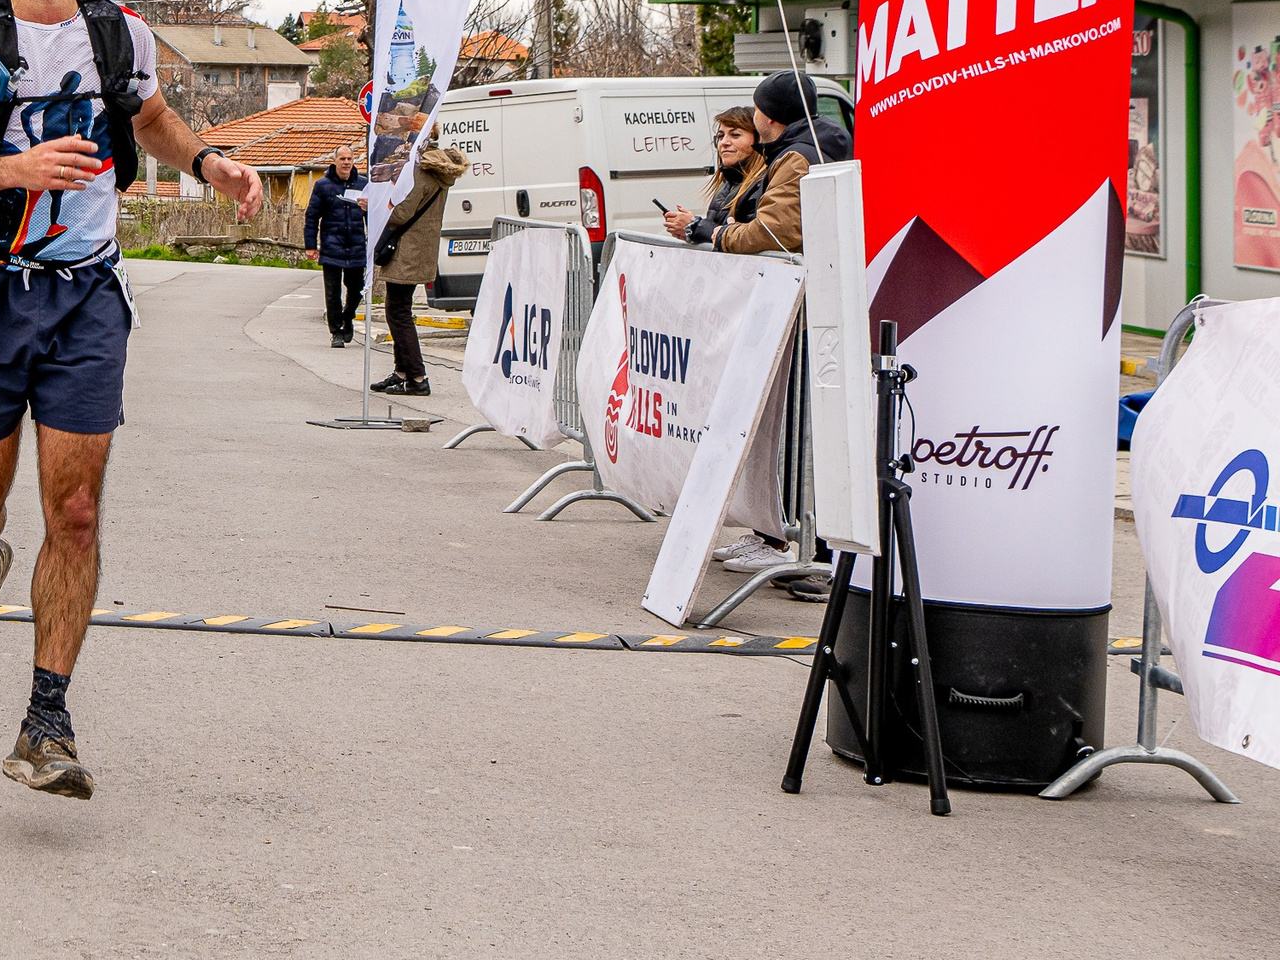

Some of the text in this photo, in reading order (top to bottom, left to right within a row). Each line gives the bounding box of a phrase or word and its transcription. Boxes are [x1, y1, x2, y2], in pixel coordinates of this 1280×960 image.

[869, 17, 1122, 118] WWW.PLOVDIV-HILLS-IN-MARKOVO.COM
[624, 108, 696, 125] KACHELÖFEN
[442, 119, 490, 136] KACHEL
[632, 136, 695, 152] LEITER
[539, 200, 577, 208] DUCATO
[629, 326, 691, 385] PLOVDIV
[667, 401, 678, 417] IN
[920, 472, 993, 489] STUDIO
